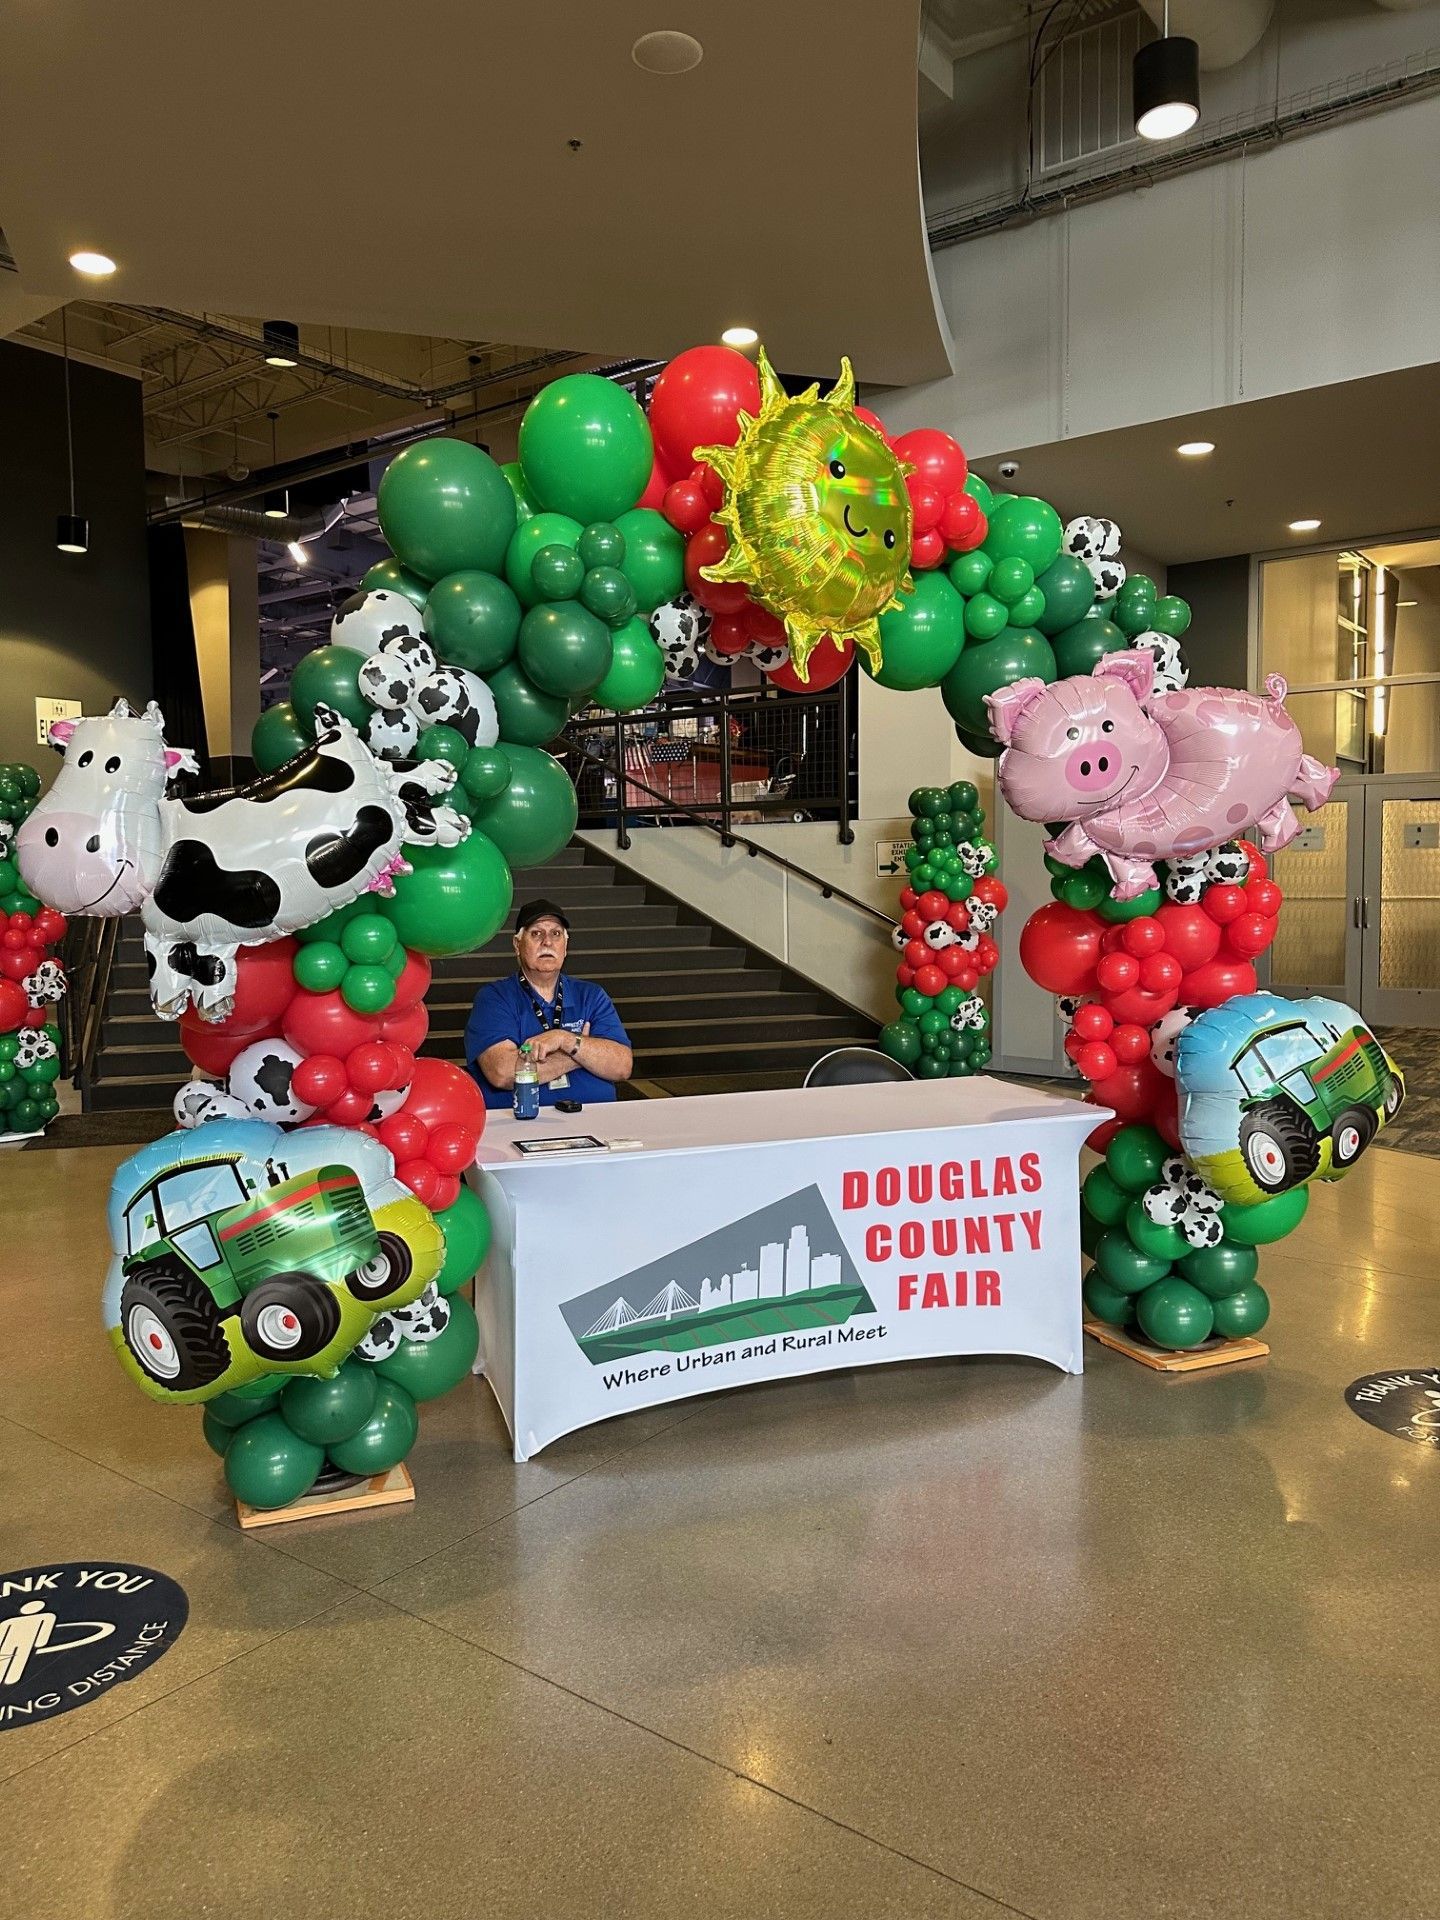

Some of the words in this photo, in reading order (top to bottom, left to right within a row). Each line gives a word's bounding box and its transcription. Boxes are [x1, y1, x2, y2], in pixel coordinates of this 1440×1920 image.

[843, 1152, 1042, 1210] DOUGLAS
[865, 1209, 1042, 1262] COUNTY
[898, 1270, 1001, 1311] FAIR
[602, 1363, 671, 1390] Where
[676, 1349, 736, 1371] Urban
[741, 1339, 776, 1360] and
[782, 1330, 832, 1351] Rural
[837, 1324, 888, 1343] Meet
[1355, 1375, 1425, 1403] THANK
[1396, 1426, 1439, 1443] FOR
[0, 1571, 64, 1598] NK
[75, 1570, 154, 1594] YOU
[0, 1693, 61, 1721] ING
[67, 1620, 168, 1697] DISTANCE
